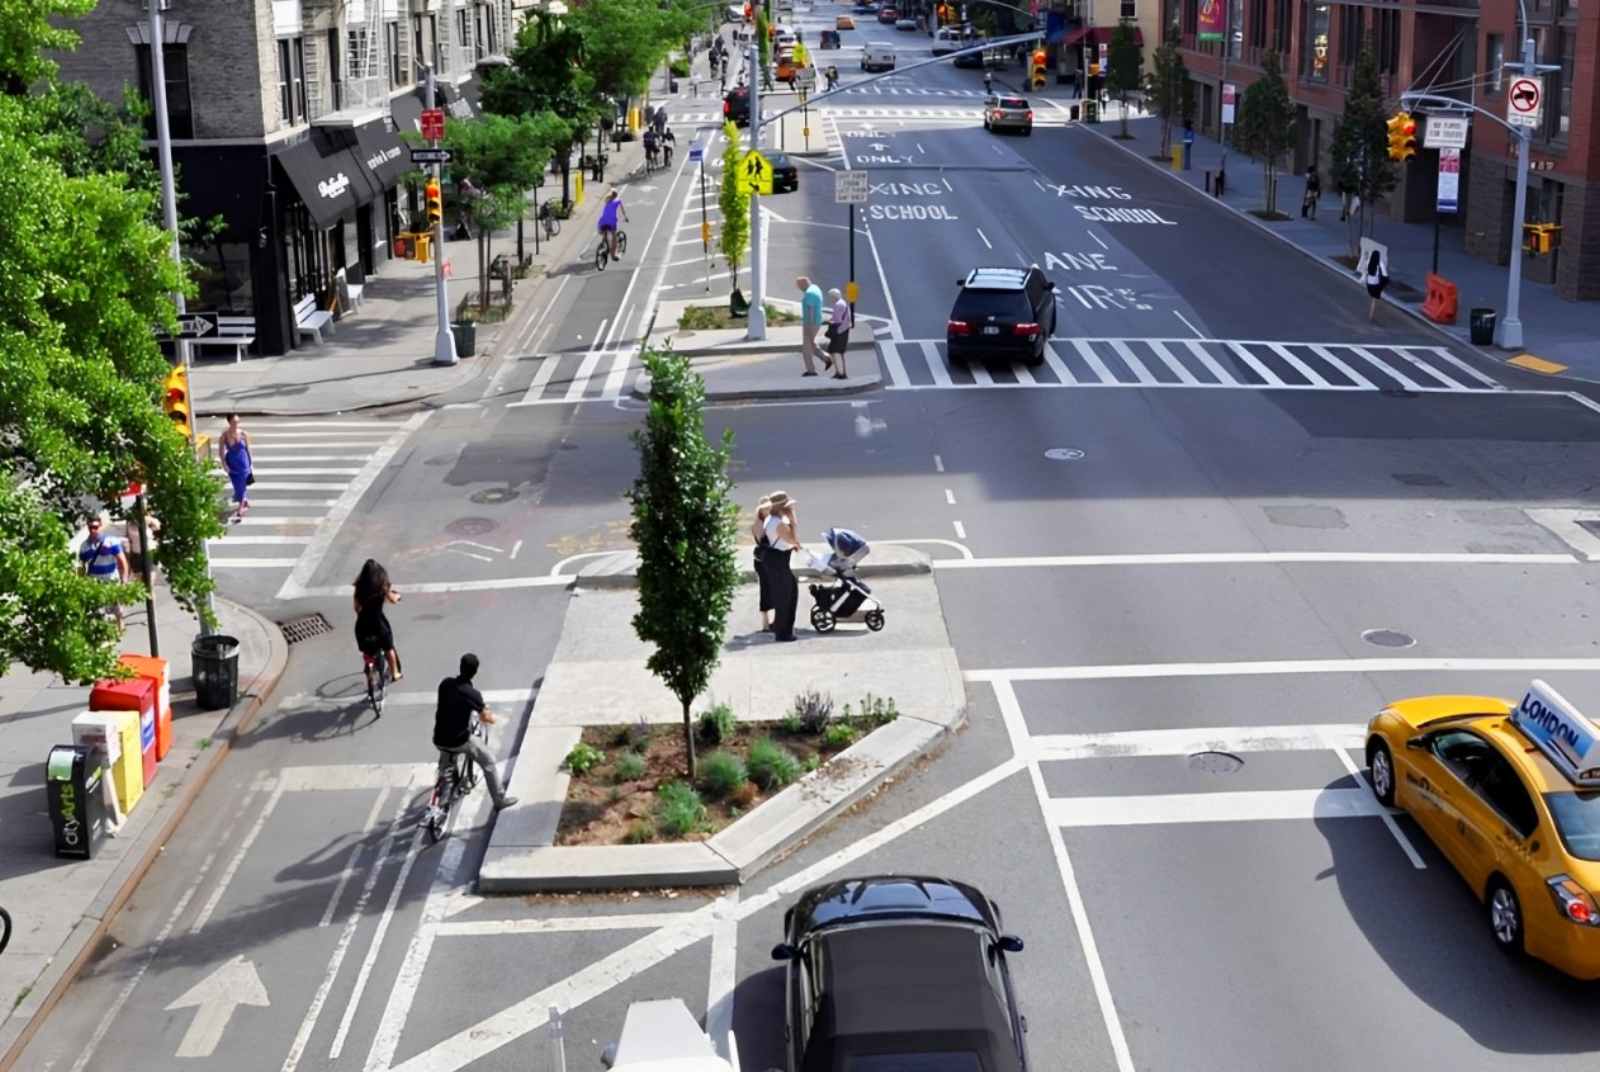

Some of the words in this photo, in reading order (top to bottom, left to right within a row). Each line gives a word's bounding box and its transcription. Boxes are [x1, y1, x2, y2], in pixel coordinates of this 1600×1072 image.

[1046, 184, 1132, 200] XING
[869, 204, 959, 220] SCHOOL
[1073, 205, 1178, 225] SCHOOL
[1041, 251, 1118, 271] ANE
[1520, 692, 1579, 747] LONDON
